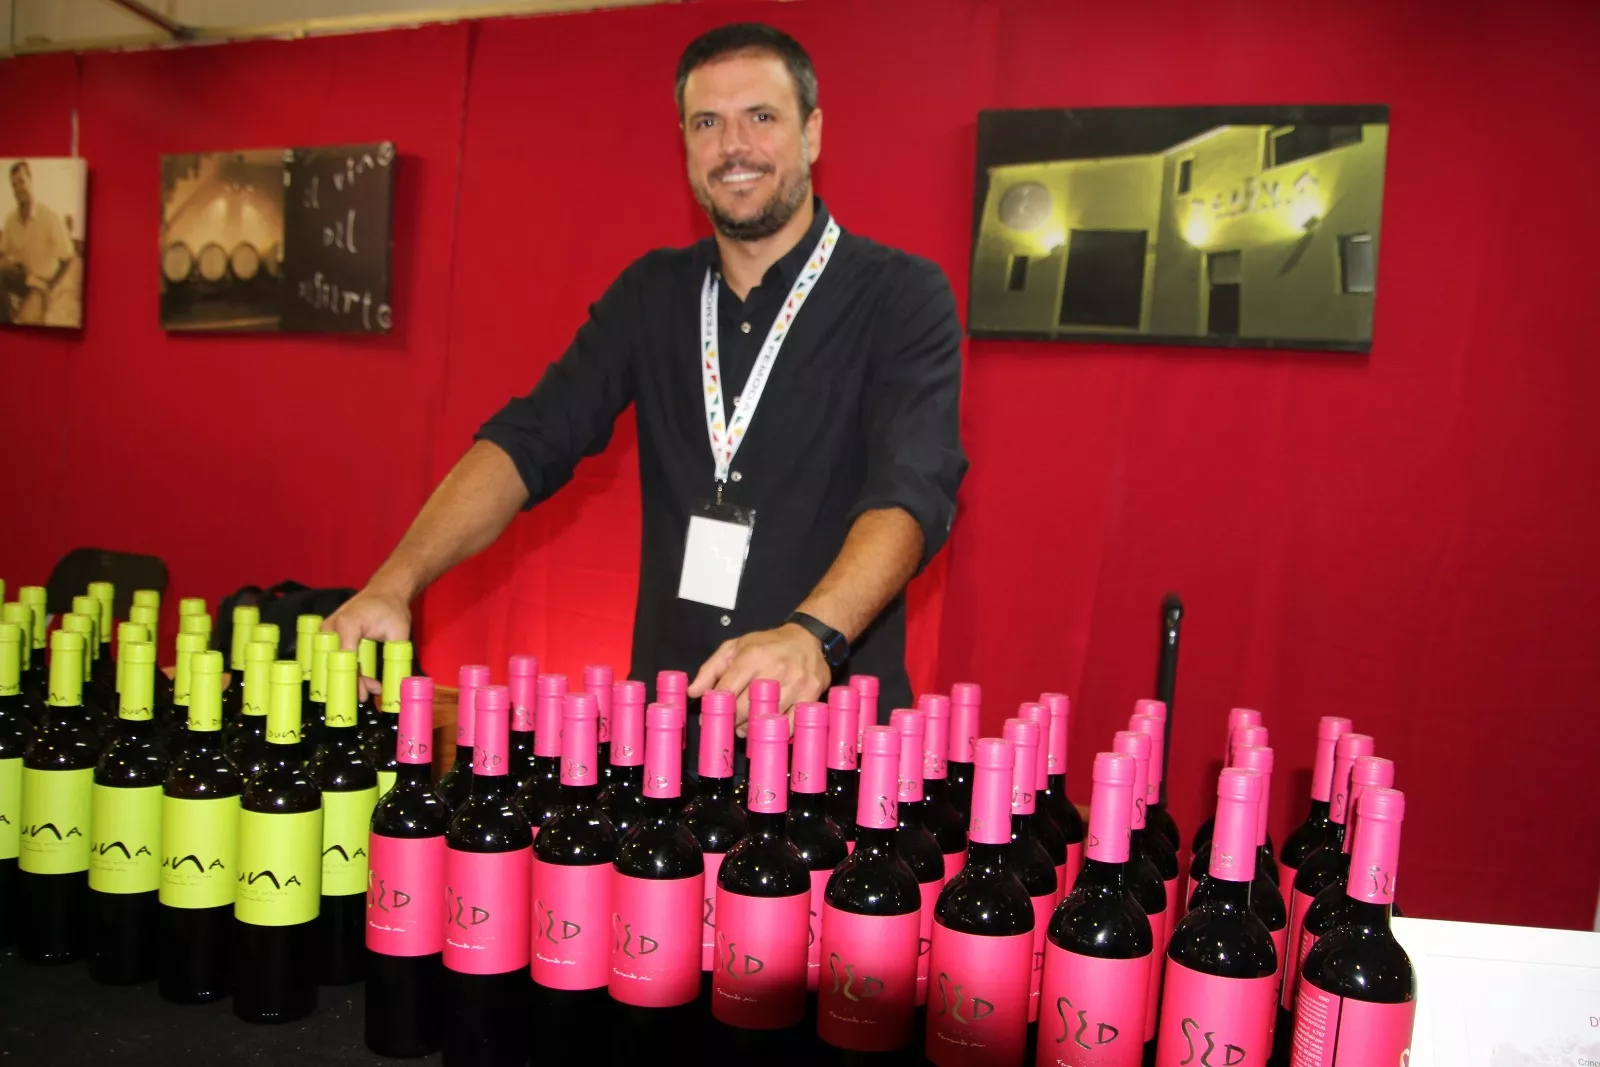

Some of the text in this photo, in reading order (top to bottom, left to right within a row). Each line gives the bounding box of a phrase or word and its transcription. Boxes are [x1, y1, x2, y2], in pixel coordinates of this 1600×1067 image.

[534, 899, 581, 944] SED
[612, 912, 659, 959] SED
[717, 930, 764, 980] SED
[829, 952, 884, 1002] SED
[937, 972, 994, 1025] SED
[1055, 996, 1119, 1050] SED
[1179, 1017, 1246, 1067] SED
